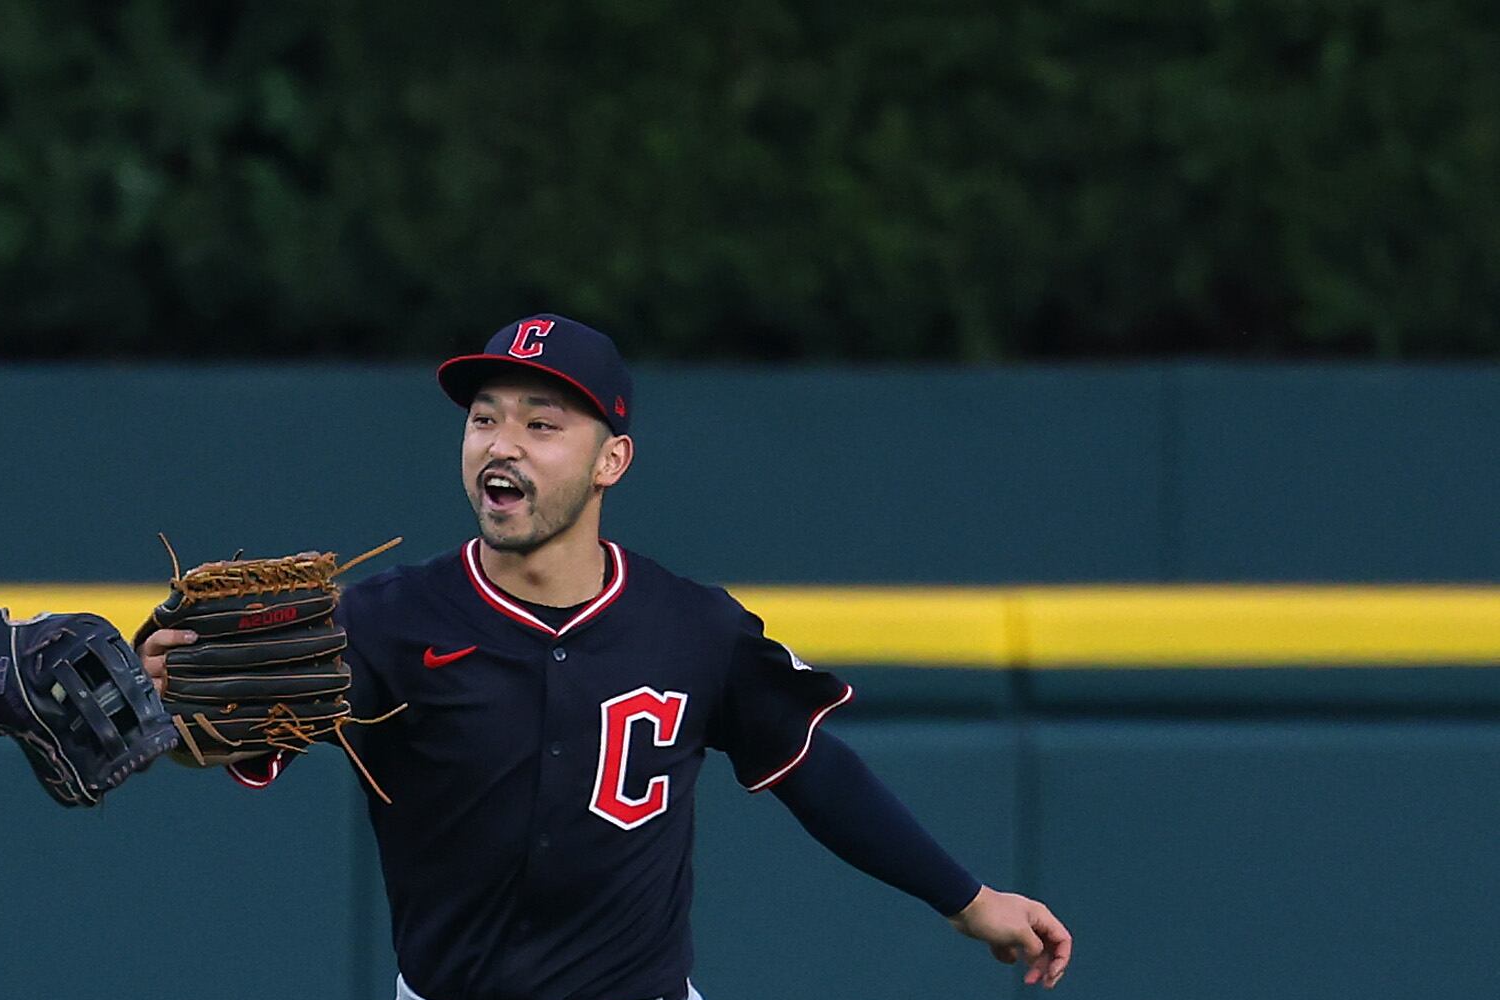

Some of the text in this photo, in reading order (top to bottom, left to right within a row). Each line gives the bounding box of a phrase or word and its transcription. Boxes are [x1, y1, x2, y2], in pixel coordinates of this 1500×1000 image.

[508, 319, 555, 358] C
[238, 606, 298, 629] A2000
[589, 686, 688, 830] C
